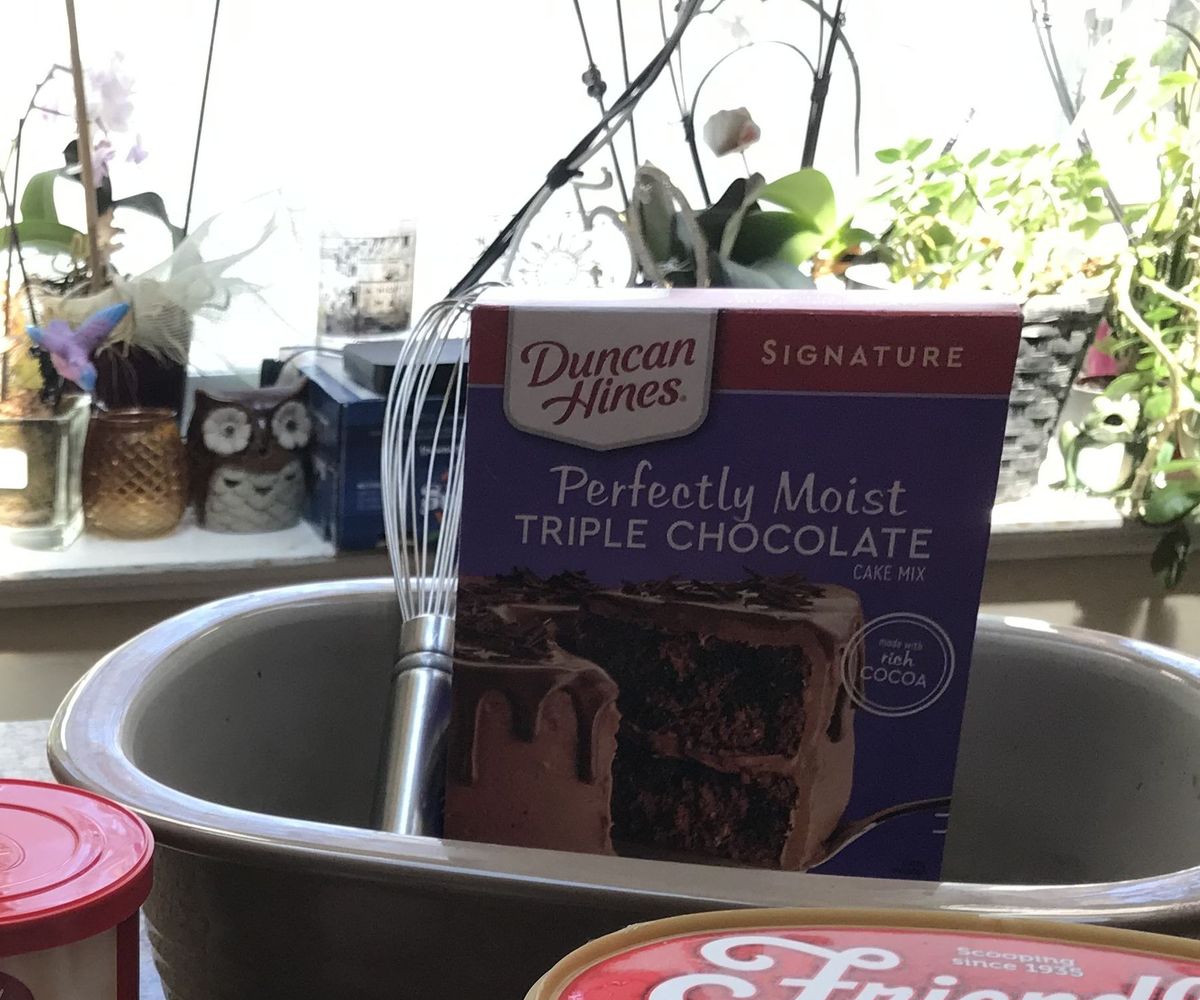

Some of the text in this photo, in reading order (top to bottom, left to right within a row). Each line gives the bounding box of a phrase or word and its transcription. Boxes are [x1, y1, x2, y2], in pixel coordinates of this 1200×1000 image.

[520, 338, 696, 387] Duncan
[760, 339, 964, 369] SIGNATURE
[541, 377, 692, 425] Hines
[550, 460, 907, 522] Perfectly Moist
[515, 515, 933, 560] TRIPLE CHOCOLATE
[852, 563, 926, 583] CAKE MIX
[904, 640, 924, 651] with
[881, 650, 915, 667] rich
[860, 665, 927, 688] COCOA
[951, 957, 1017, 971] since
[957, 946, 1076, 968] Scooping
